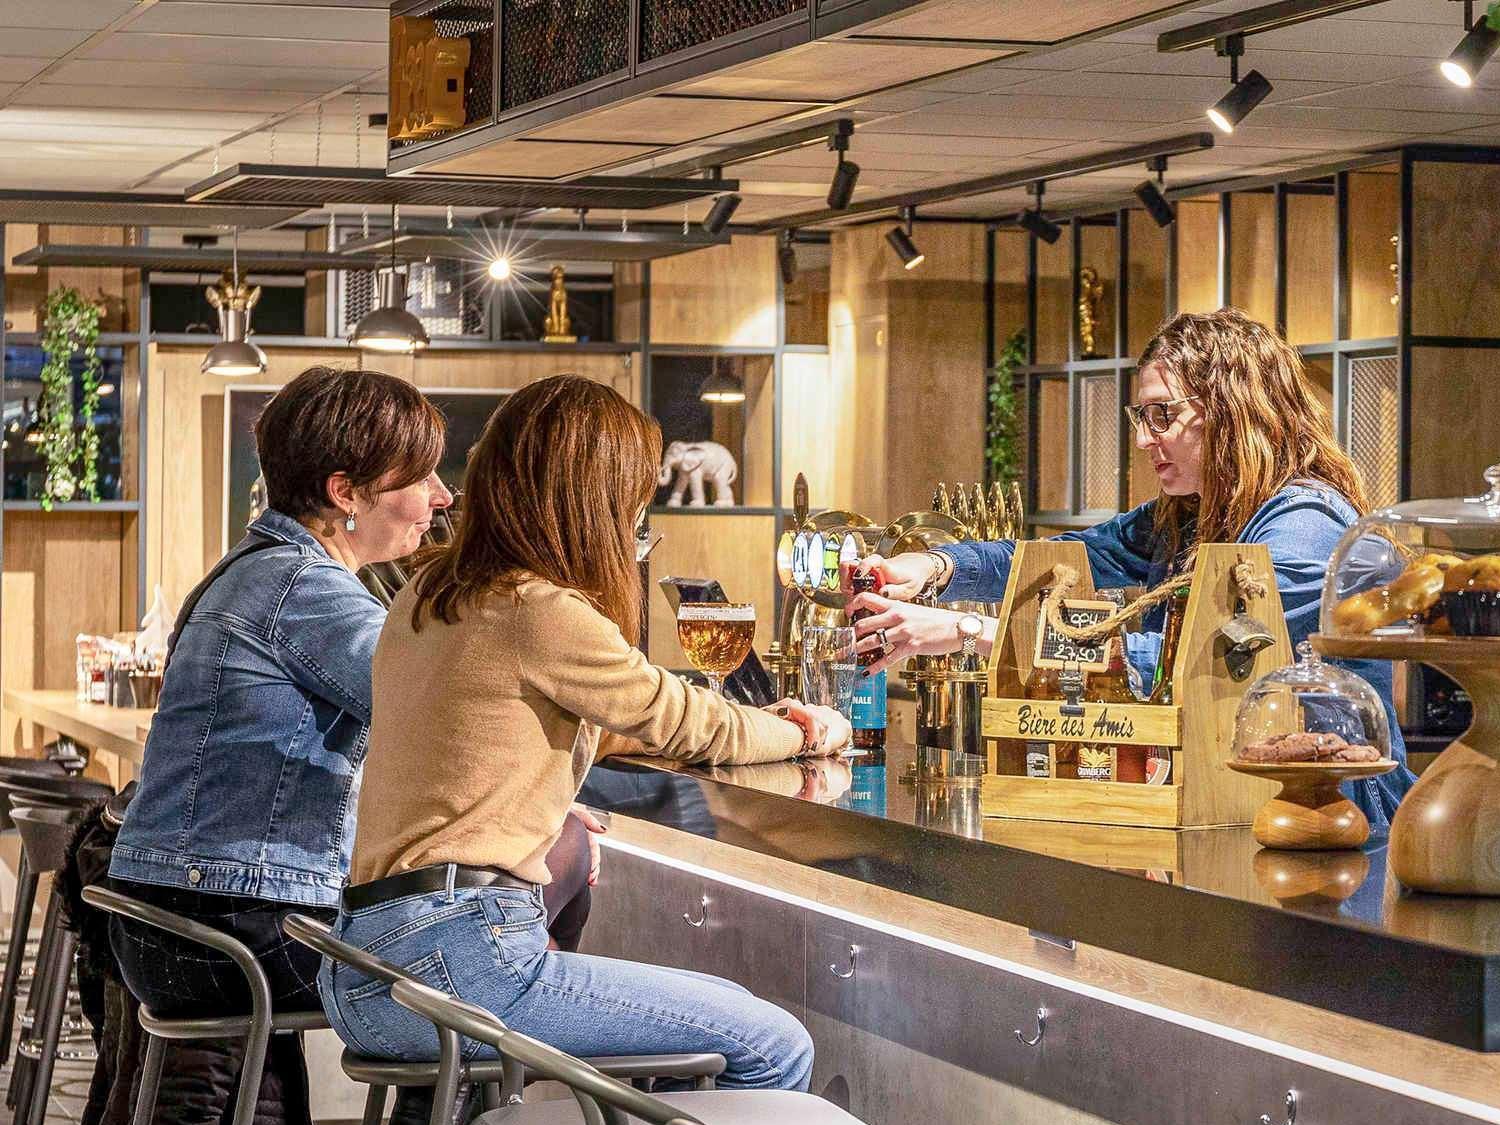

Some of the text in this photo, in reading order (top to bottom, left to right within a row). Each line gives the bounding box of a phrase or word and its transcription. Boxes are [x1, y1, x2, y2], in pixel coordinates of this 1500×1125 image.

[851, 695, 872, 705] NALE
[1017, 704, 1135, 739] Bière des Amis
